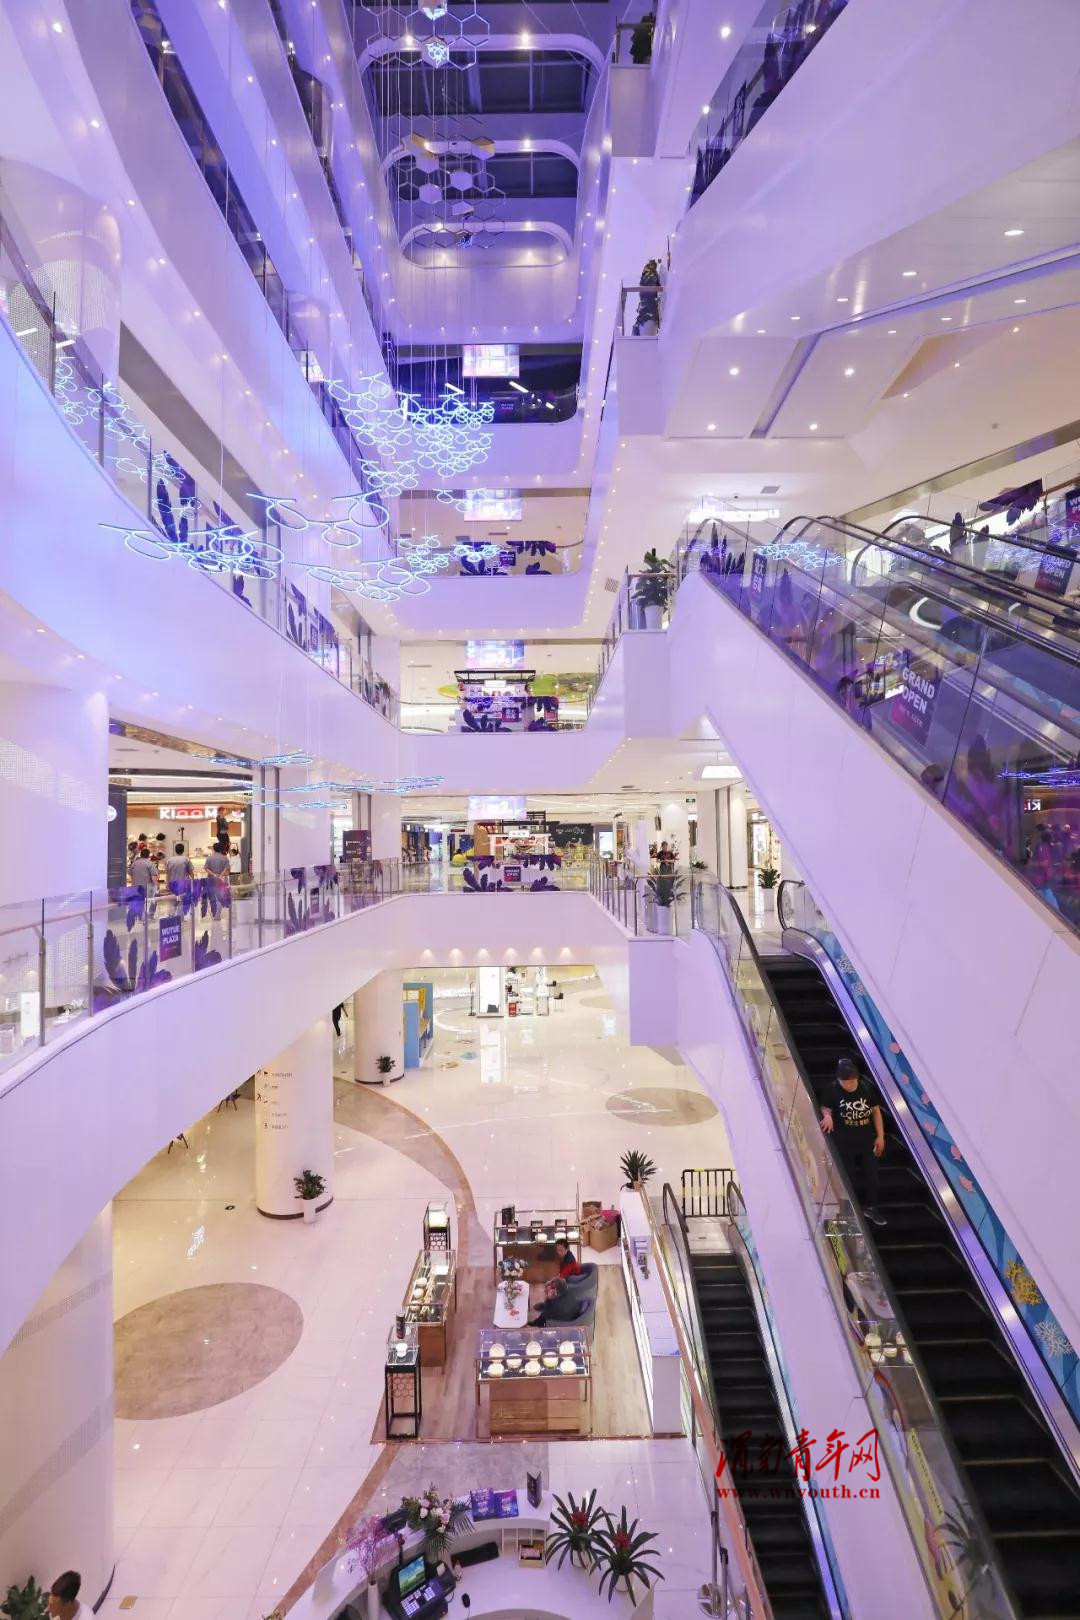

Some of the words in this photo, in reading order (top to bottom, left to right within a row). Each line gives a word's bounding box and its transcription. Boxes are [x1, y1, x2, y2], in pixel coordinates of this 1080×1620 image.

[1045, 564, 1065, 578] OPEN
[902, 667, 935, 699] GRAND
[902, 686, 928, 714] OPEN
[161, 925, 180, 936] WUYUE
[162, 934, 179, 945] PLAZA
